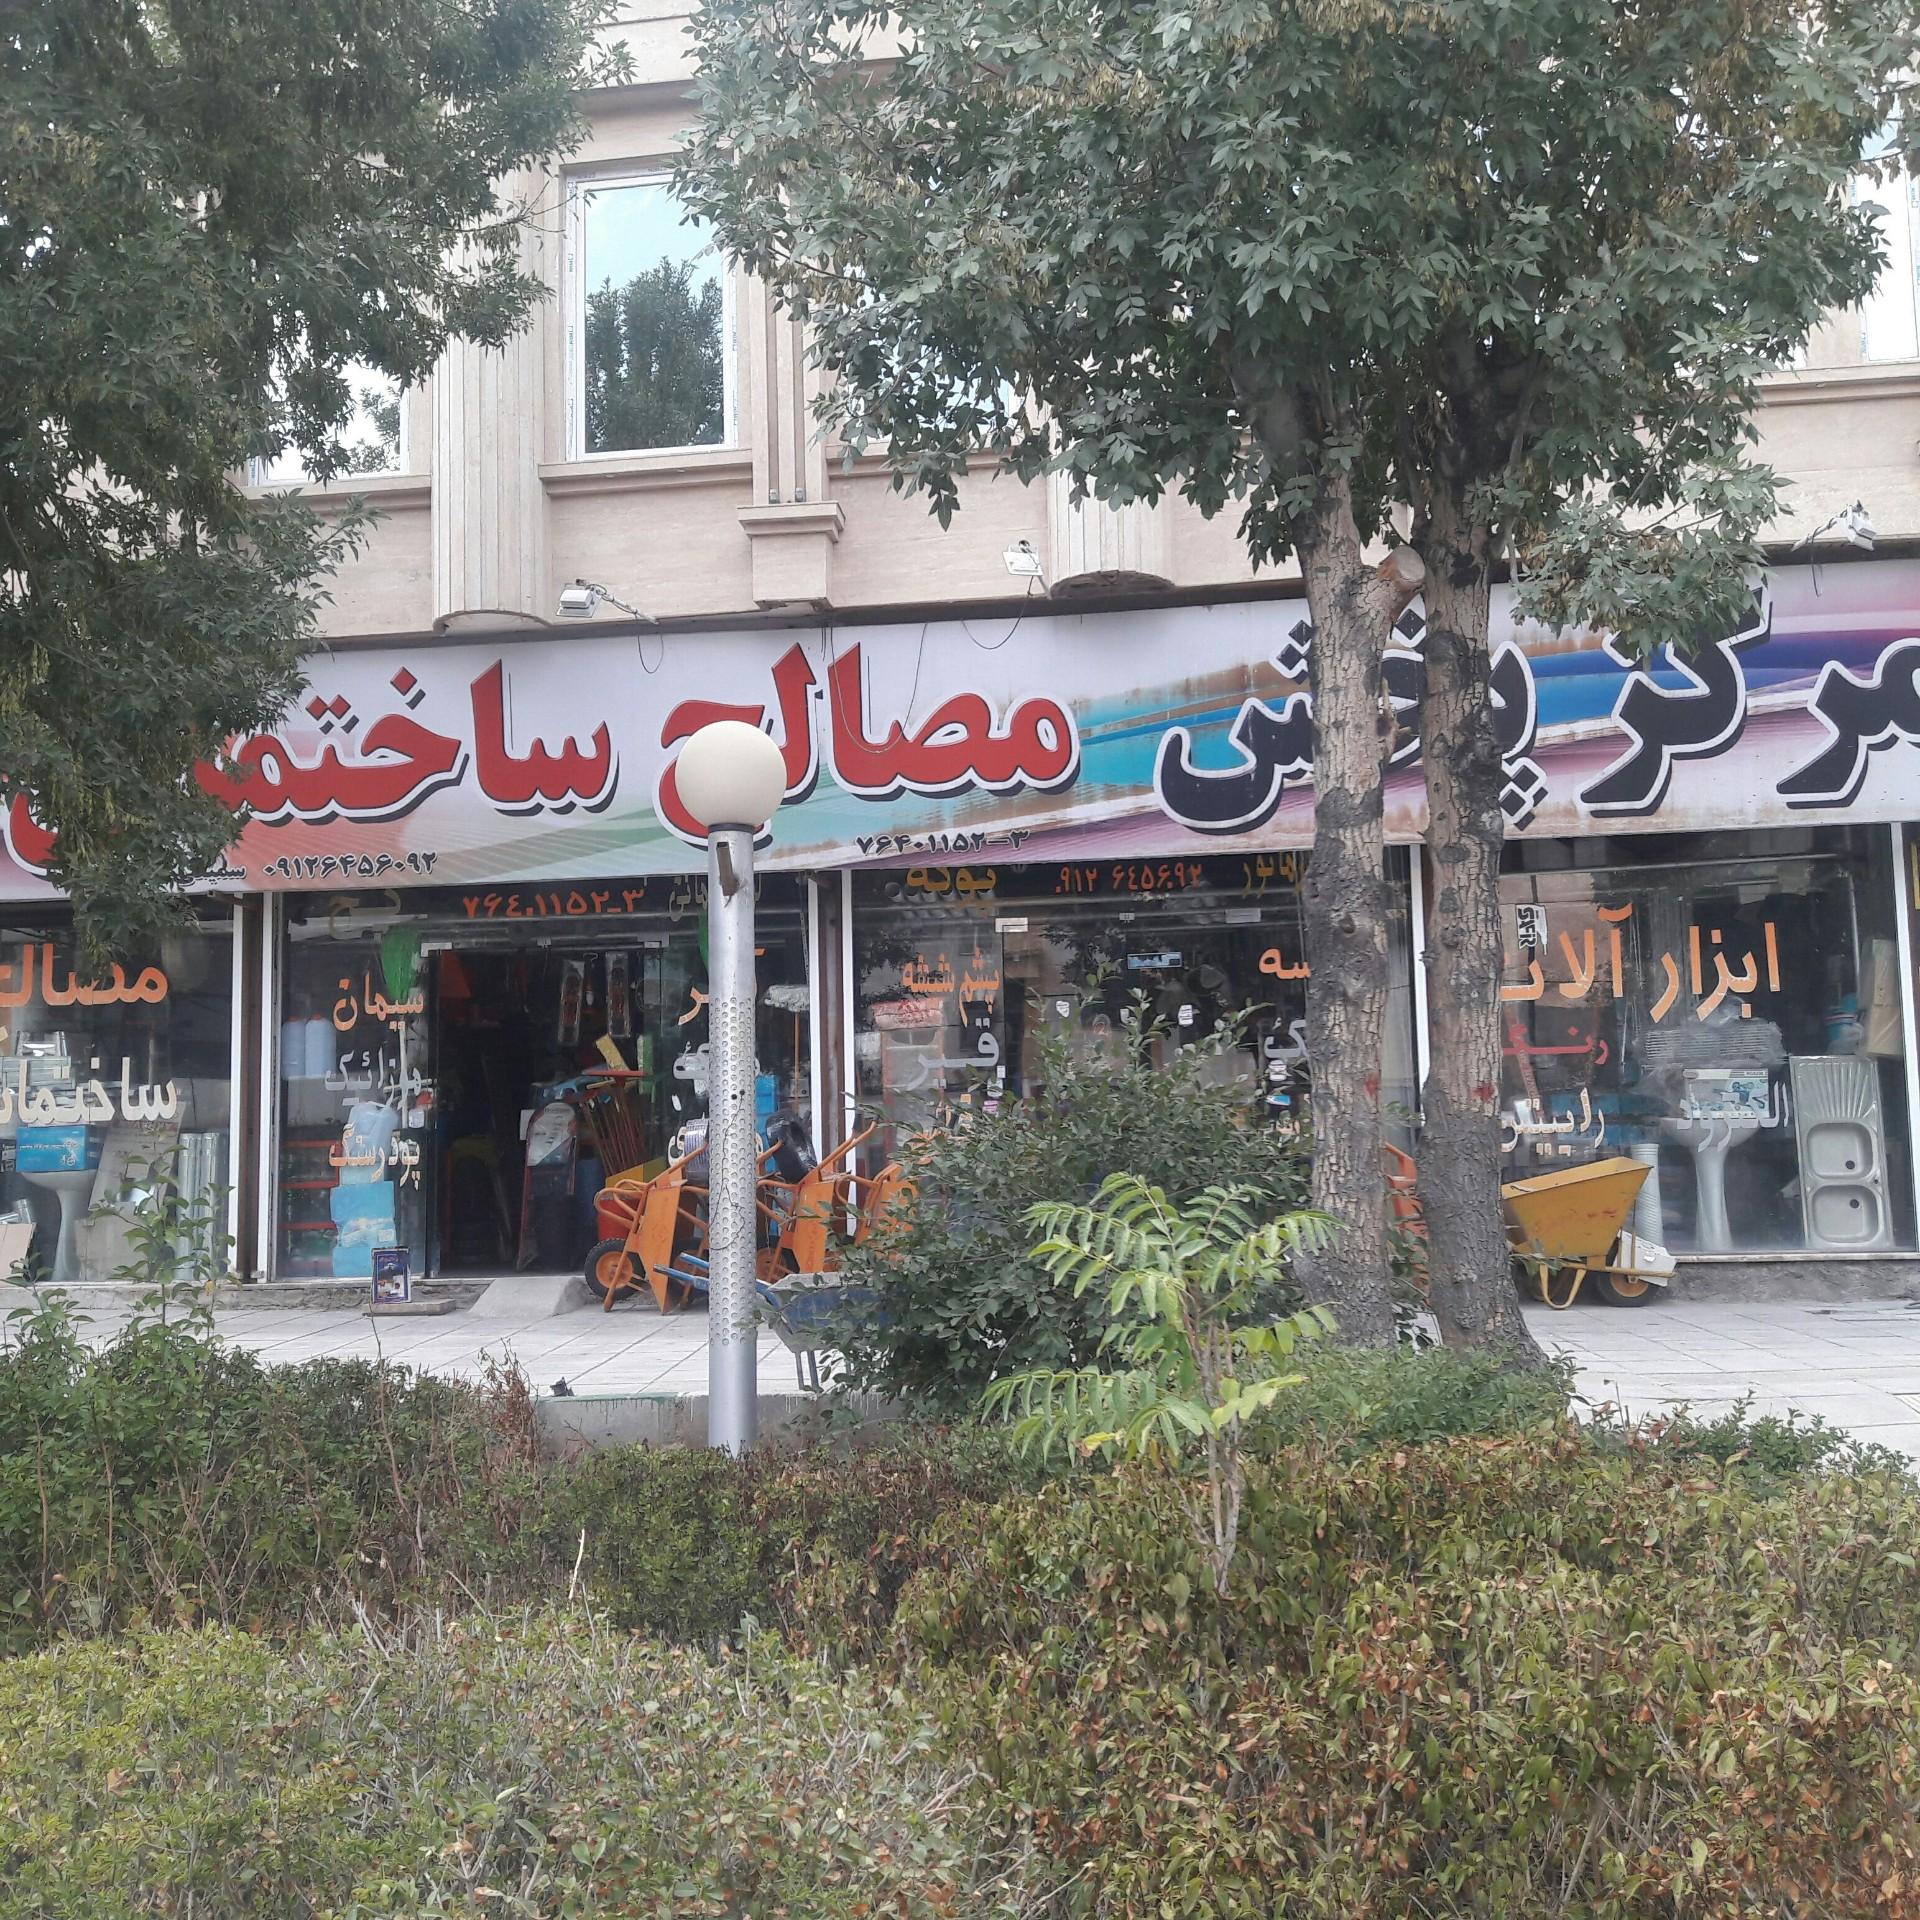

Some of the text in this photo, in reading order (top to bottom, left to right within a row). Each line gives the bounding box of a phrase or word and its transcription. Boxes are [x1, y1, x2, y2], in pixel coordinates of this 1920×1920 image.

[333, 970, 424, 1031] سیمان
[1650, 921, 1781, 1023] ابزار
[917, 1017, 1000, 1091] قیر
